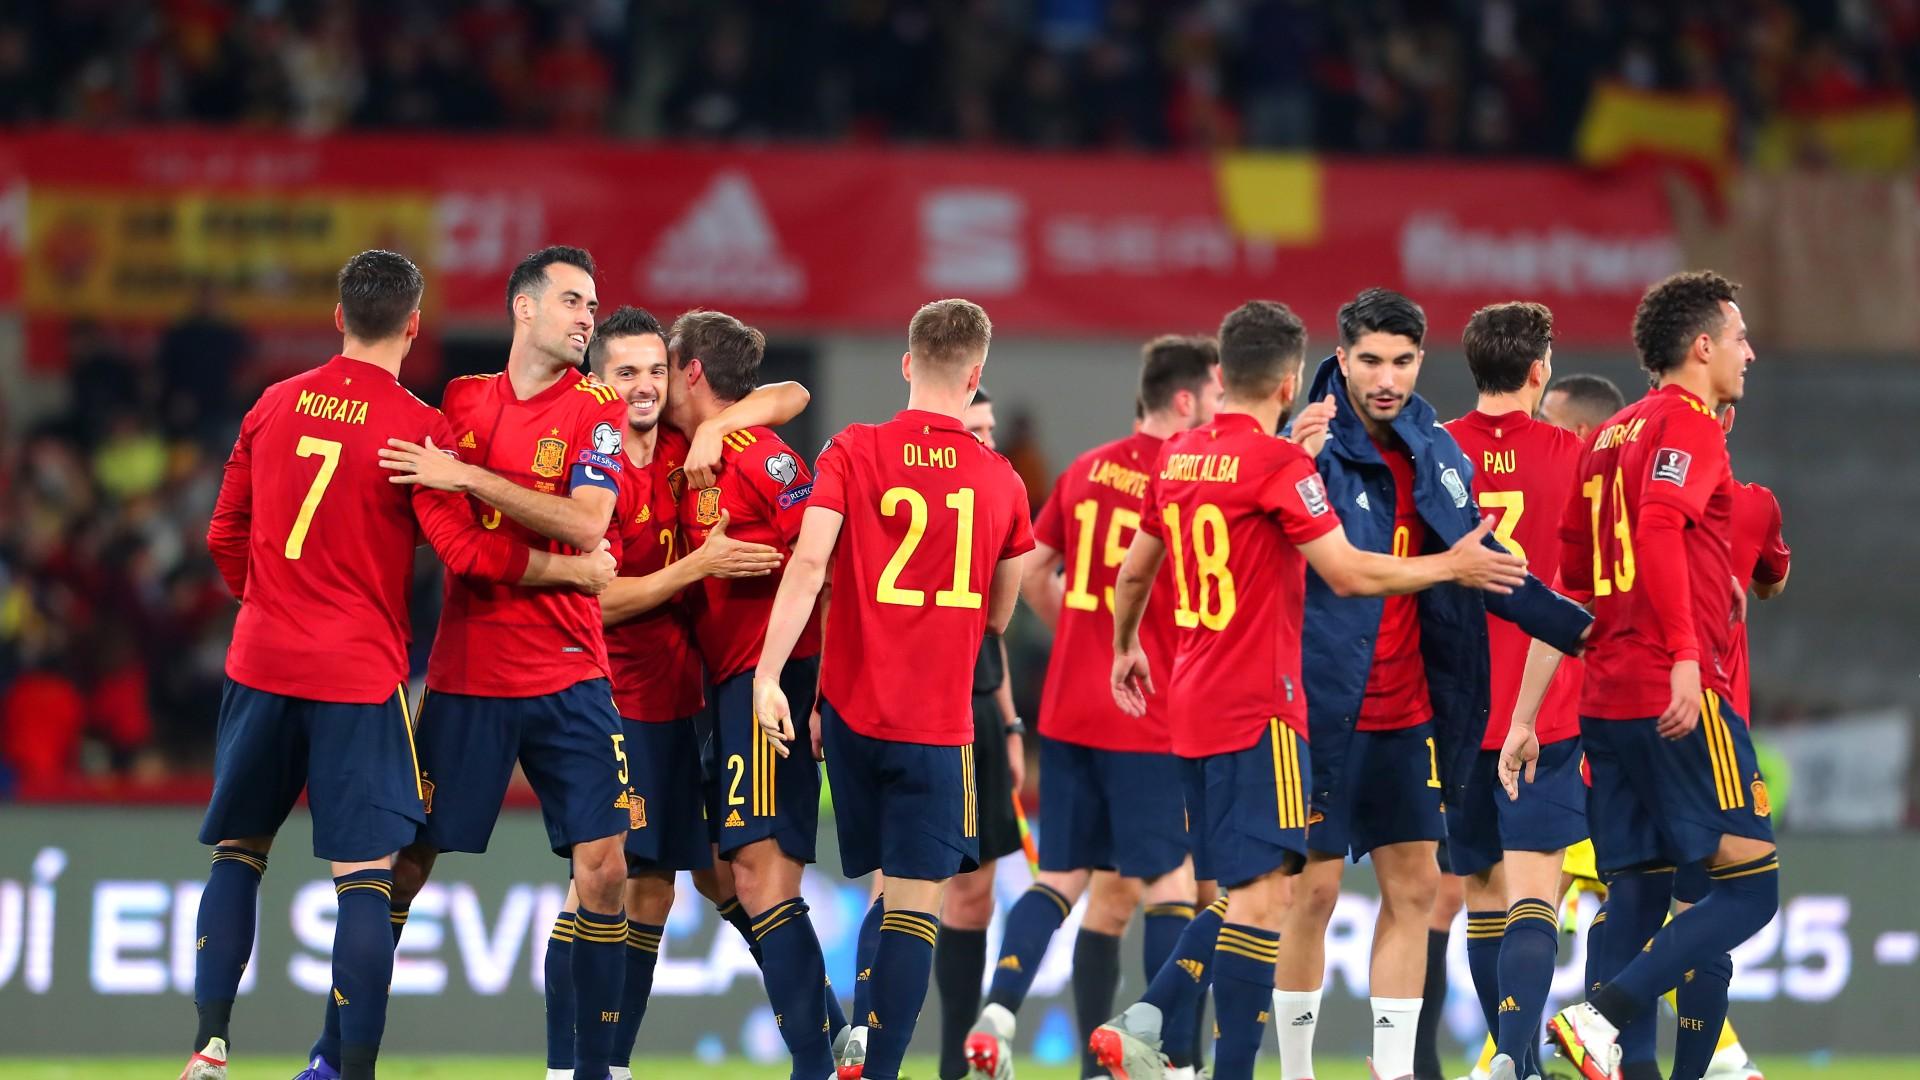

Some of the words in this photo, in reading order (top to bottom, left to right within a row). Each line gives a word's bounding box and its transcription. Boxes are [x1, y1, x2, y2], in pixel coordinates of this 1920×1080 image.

[295, 390, 369, 425] MORATA
[591, 454, 621, 473] RESPECT
[903, 443, 957, 469] OLMO
[1160, 453, 1203, 480] JORDI
[1199, 454, 1240, 483] ALBA
[1483, 450, 1516, 474] PAU
[285, 435, 343, 560] 7
[790, 486, 814, 500] RESPEC
[1088, 459, 1151, 499] LAPORTE
[876, 486, 982, 609] 21
[1582, 465, 1636, 596] 19
[1162, 502, 1237, 631] 18
[610, 734, 629, 784] 5
[727, 754, 745, 806] 2
[1679, 1016, 1705, 1031] RFEF
